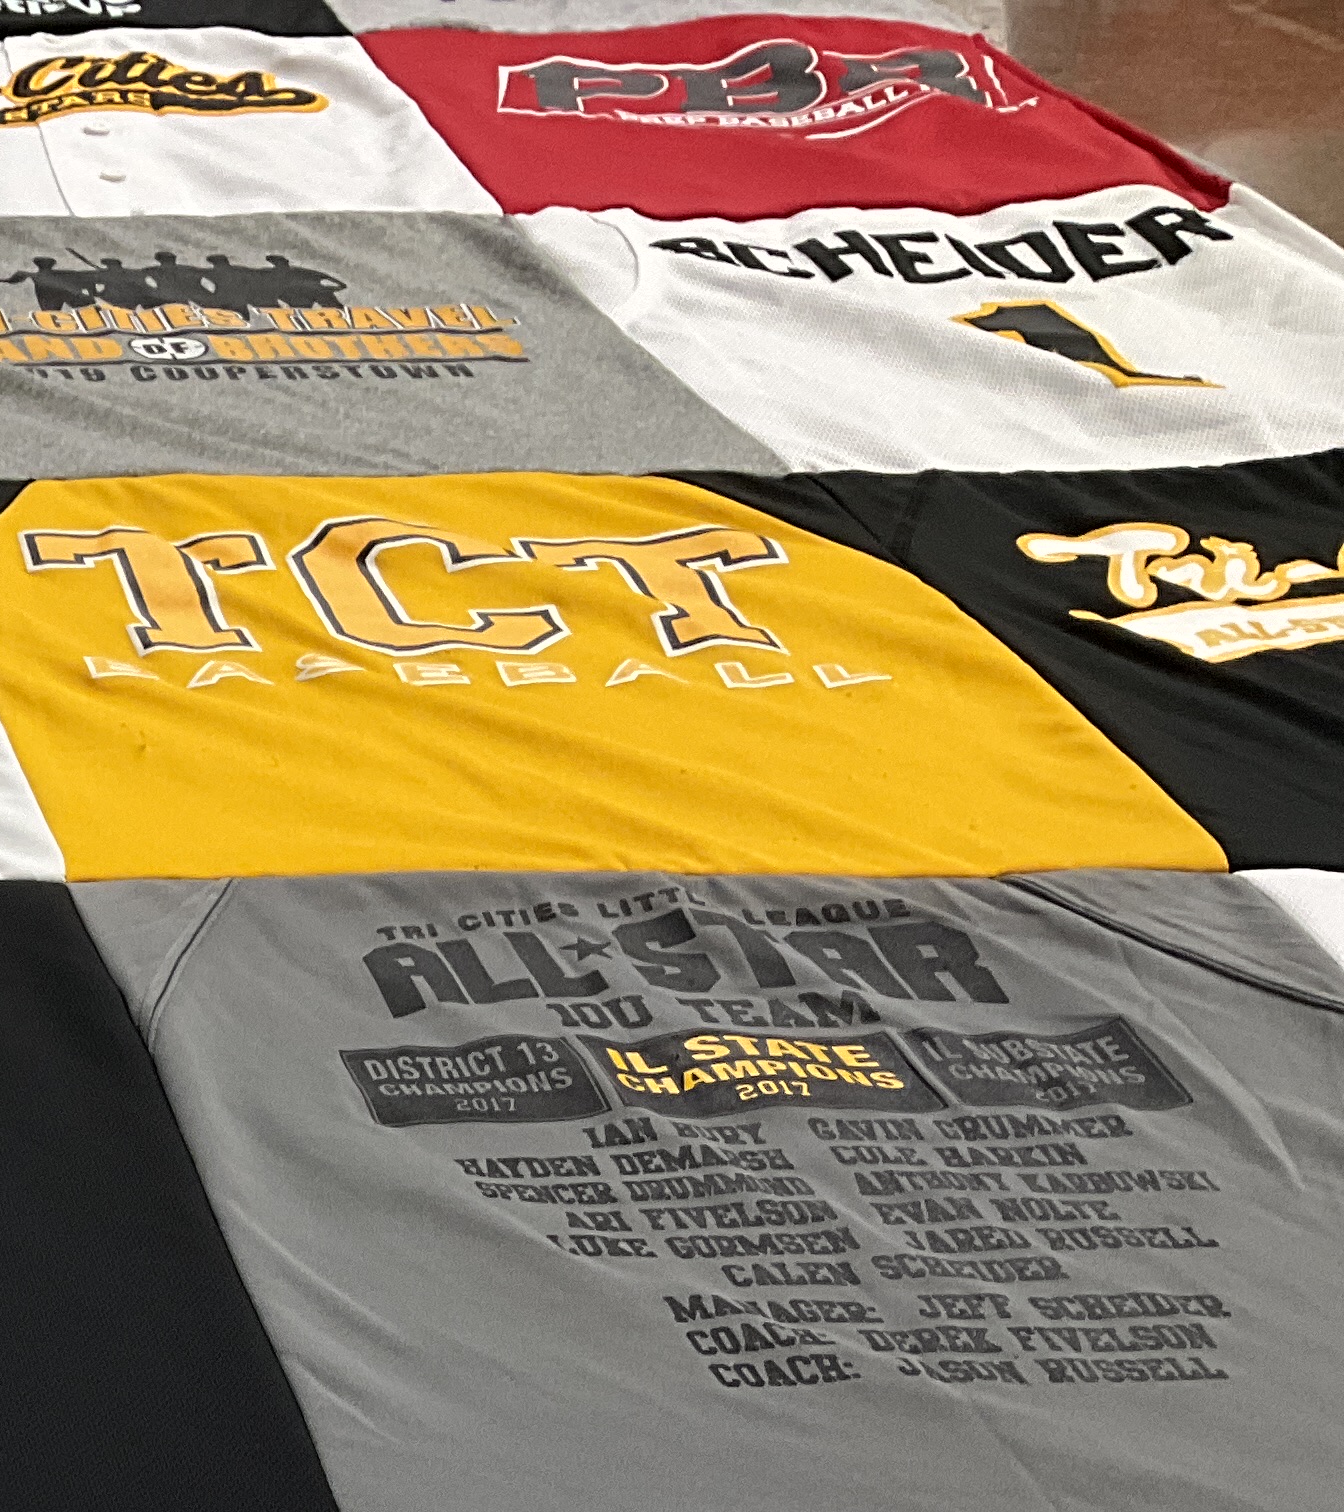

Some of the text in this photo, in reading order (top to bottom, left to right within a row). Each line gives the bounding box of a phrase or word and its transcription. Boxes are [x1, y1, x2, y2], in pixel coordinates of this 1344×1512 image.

[718, 86, 909, 127] BASEBALL
[648, 205, 1235, 285] SCHEIDER
[253, 302, 521, 332] TRAVEL
[208, 333, 524, 362] BROTHERS
[130, 363, 475, 383] COOPERSTOWN
[1016, 521, 1344, 609] Tri-
[16, 515, 791, 658] TCT
[83, 655, 893, 689] BASEBALL
[375, 886, 911, 941] TRI CITIES LITTL LEAGUE
[546, 989, 882, 1029] 10U TEAM
[363, 1041, 560, 1082] DISTRICT 13
[605, 1034, 883, 1076] IL STATE
[921, 1036, 962, 1062] IL
[378, 1066, 574, 1097] CHAMPIONS
[616, 1055, 905, 1097] CHAMPIONS
[734, 1077, 812, 1103] 2017
[454, 1096, 517, 1112] 2017
[582, 1116, 767, 1149] IAN BURY
[807, 1116, 925, 1141] GAVIN
[454, 1144, 795, 1179] HAYDEN DEMARSH
[830, 1145, 928, 1166] COLE
[475, 1172, 816, 1205] SPENCER DRUMMOND
[853, 1169, 1012, 1196] ANTHONY
[566, 1198, 839, 1232] ARI FIVELSON
[870, 1197, 1123, 1225] EVAN NOLTE
[546, 1227, 861, 1259] LUKE GORMSEN
[903, 1225, 1220, 1254] JARED RUSSELL
[722, 1253, 1071, 1287] CALEN SCHEIDER
[663, 1291, 1233, 1324] MANAGER: JEFF SCHEIDER
[686, 1321, 1219, 1356] COACH: DEREK FIVELSON
[708, 1353, 1230, 1388] COACH: JASON RUSSELL
